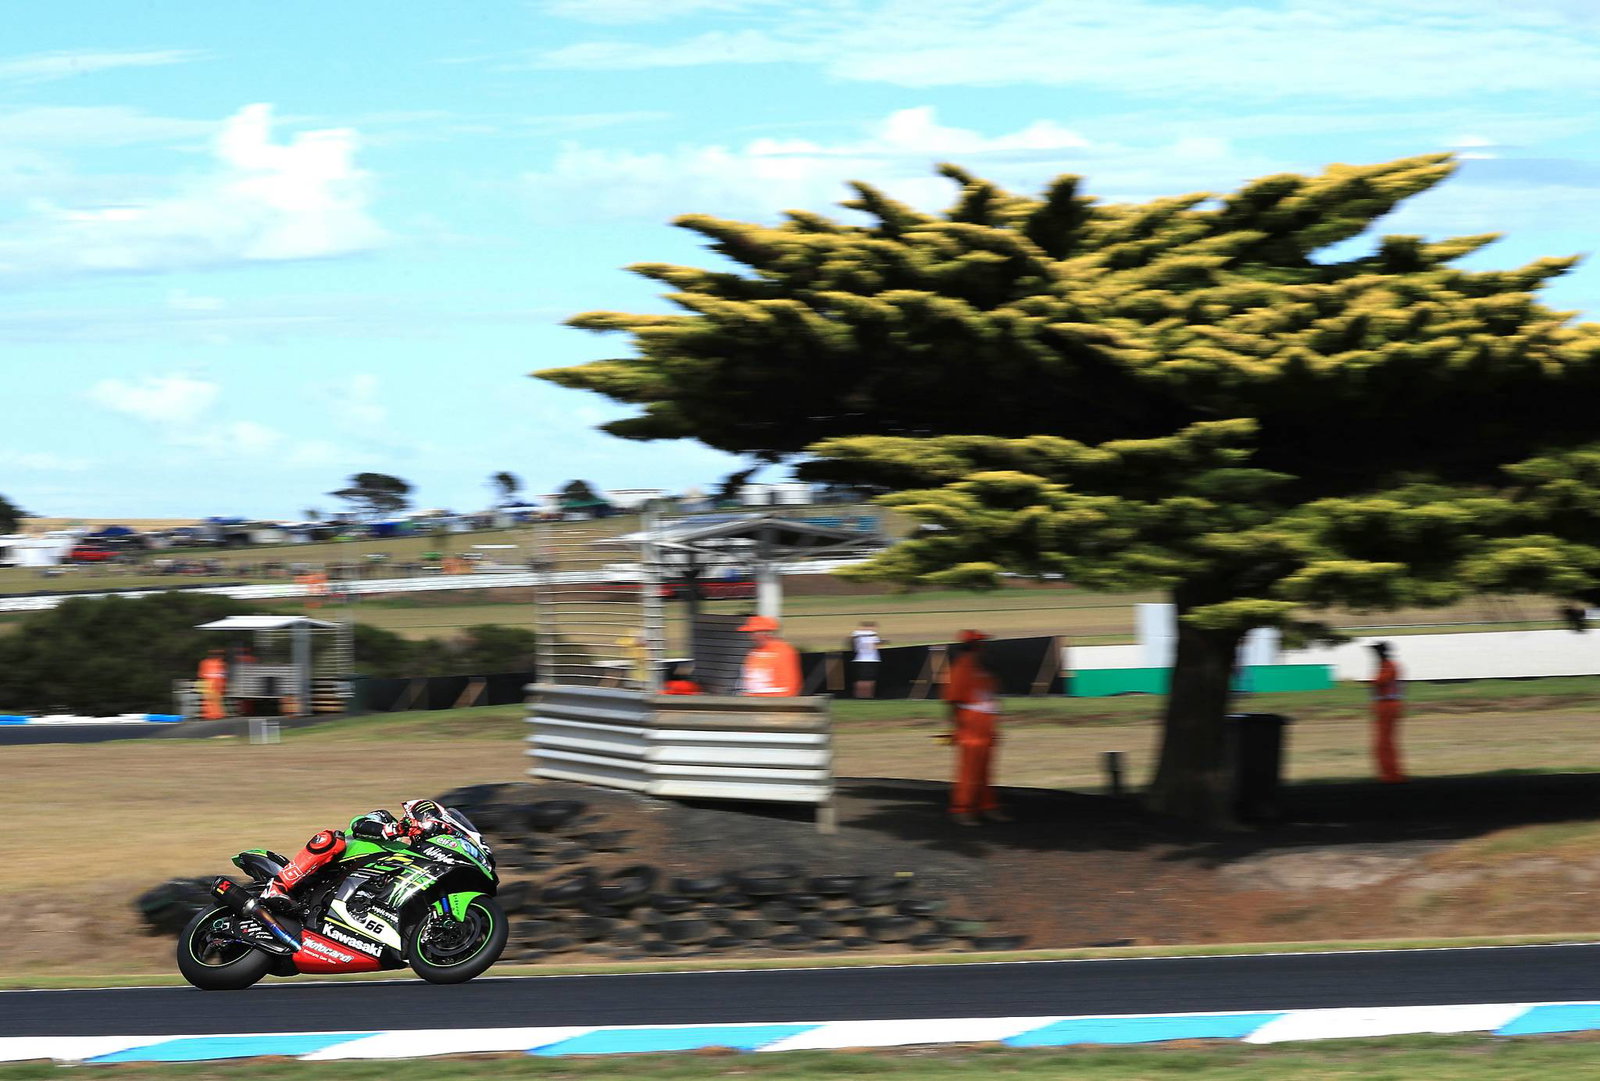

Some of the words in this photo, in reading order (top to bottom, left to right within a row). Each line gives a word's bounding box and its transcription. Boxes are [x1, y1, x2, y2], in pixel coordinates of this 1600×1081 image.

[423, 847, 455, 864] Ninja
[365, 920, 384, 934] 66
[322, 923, 384, 958] Kawasaki
